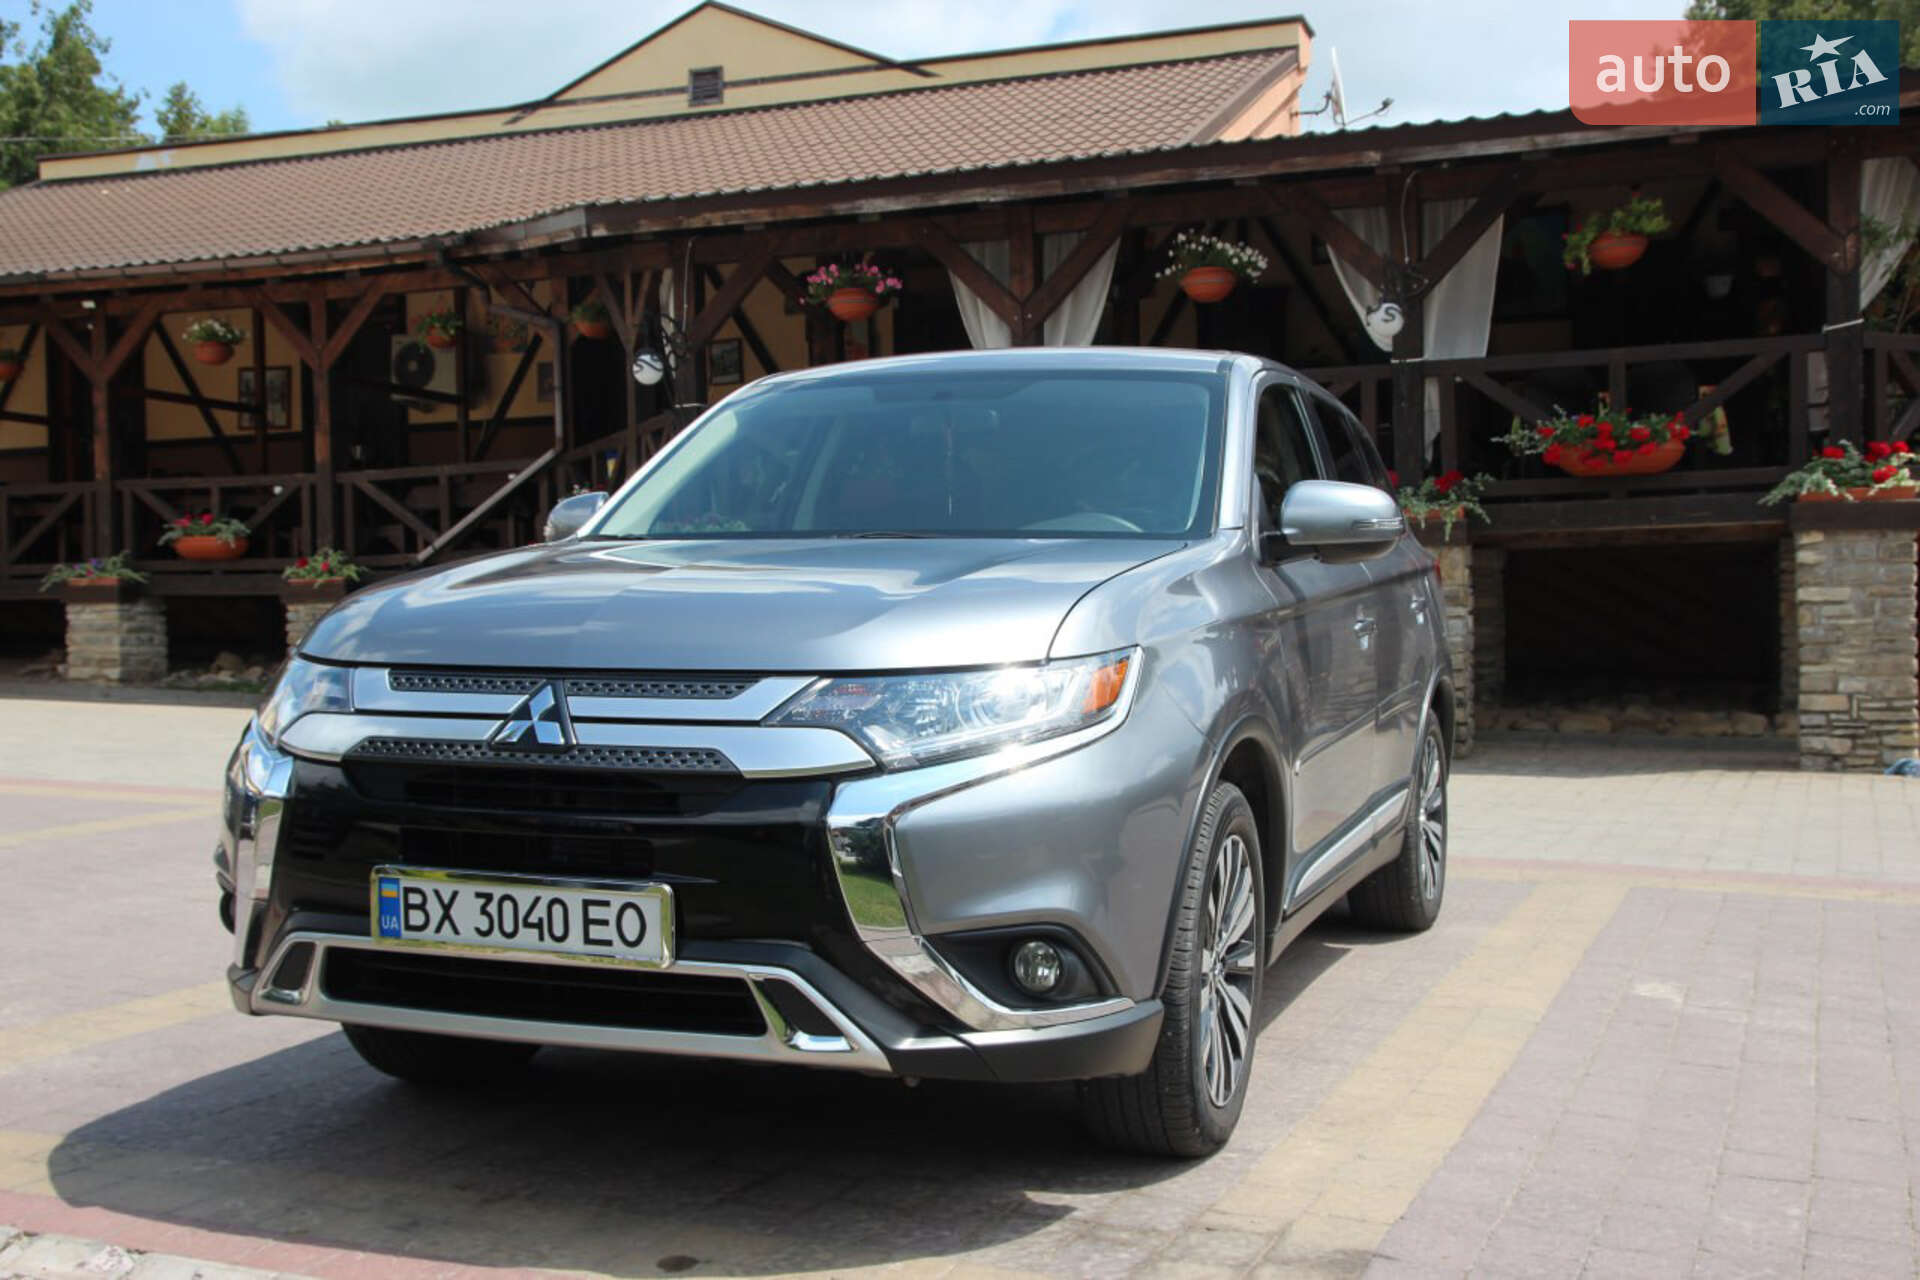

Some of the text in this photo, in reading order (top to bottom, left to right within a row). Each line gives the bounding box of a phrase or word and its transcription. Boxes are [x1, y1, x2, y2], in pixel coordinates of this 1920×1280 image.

[381, 916, 399, 931] UA
[402, 886, 647, 948] BX 3040 EO
